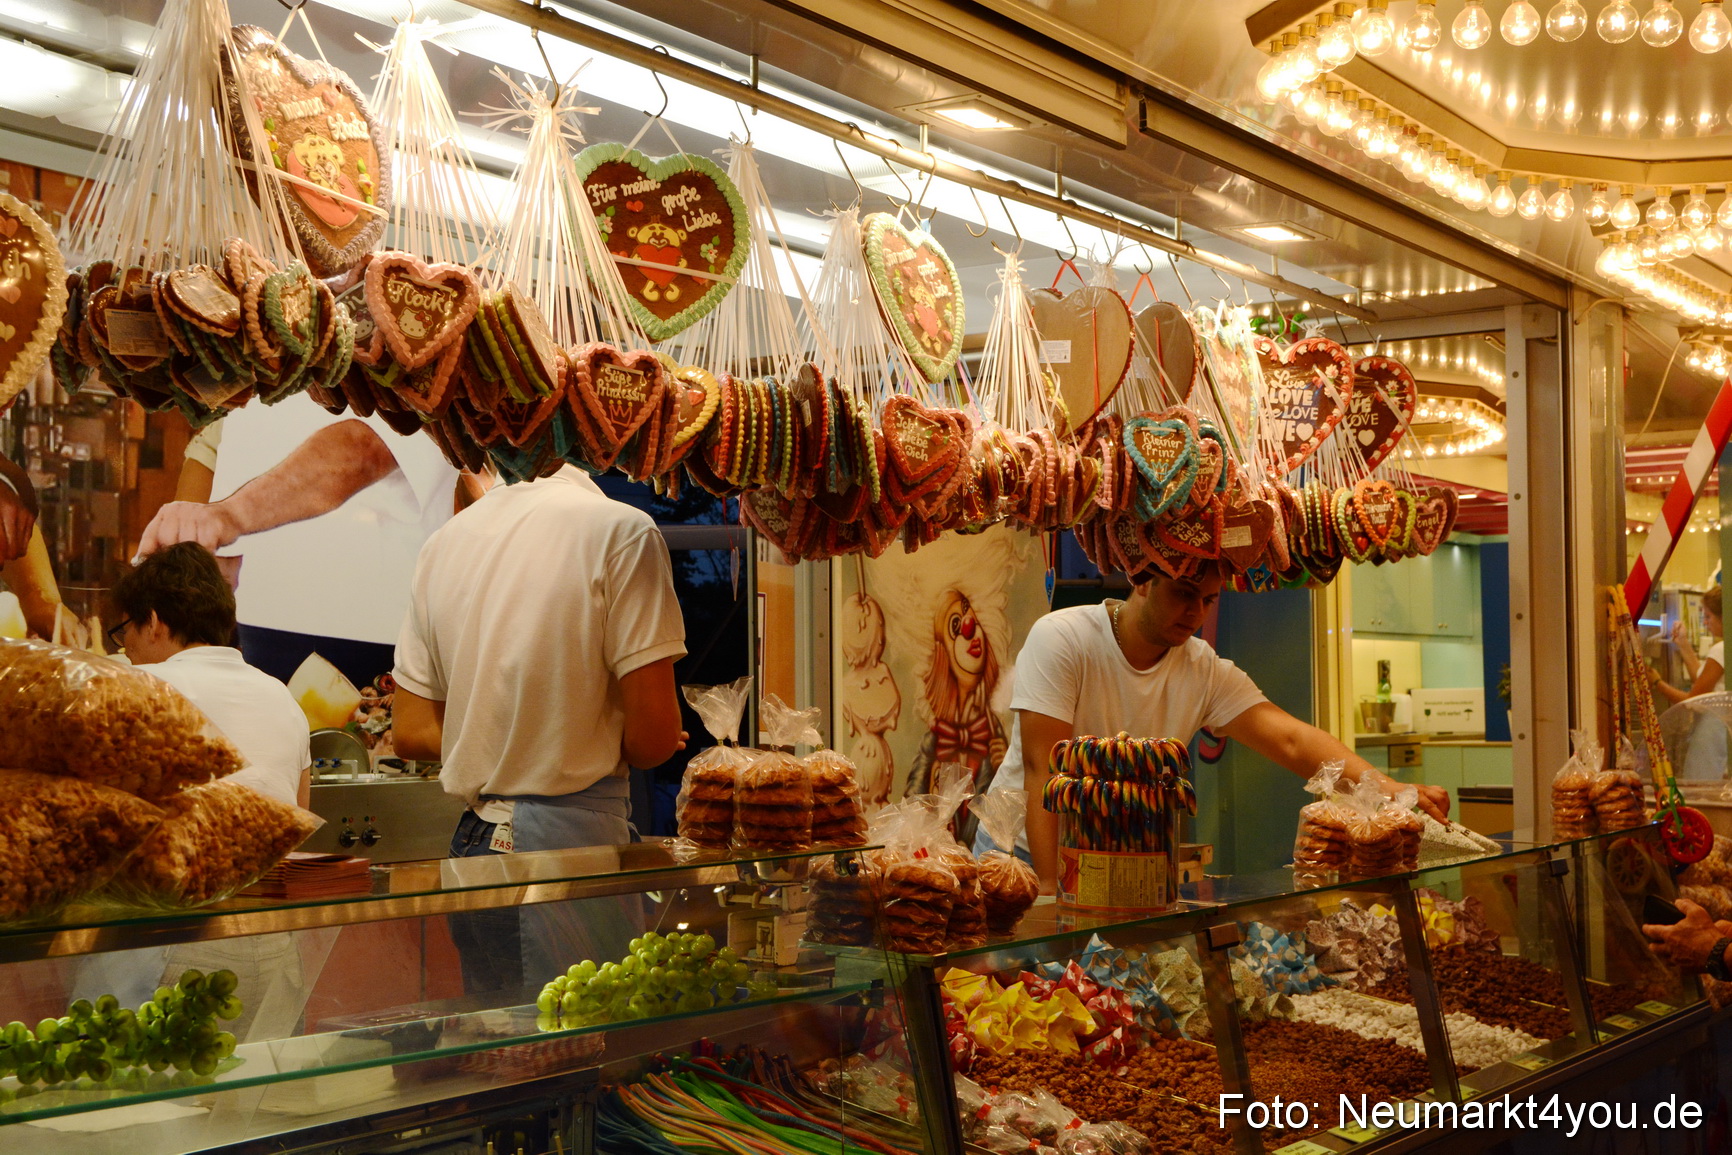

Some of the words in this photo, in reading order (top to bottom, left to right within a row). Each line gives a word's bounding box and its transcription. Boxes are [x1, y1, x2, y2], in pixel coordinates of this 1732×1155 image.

[587, 183, 618, 207] Für
[620, 175, 661, 197] meine
[661, 185, 701, 216] große
[681, 208, 722, 232] Liebe
[1270, 370, 1307, 390] Love
[1269, 388, 1314, 407] LOVE
[1282, 405, 1319, 421] LOVE
[1349, 412, 1379, 427] OVE
[1142, 431, 1183, 449] Kleiner
[904, 444, 929, 462] Dich
[1141, 444, 1176, 459] Prinz
[1416, 511, 1440, 530] Engel
[1178, 522, 1204, 541] liebe
[1188, 530, 1213, 547] Dich
